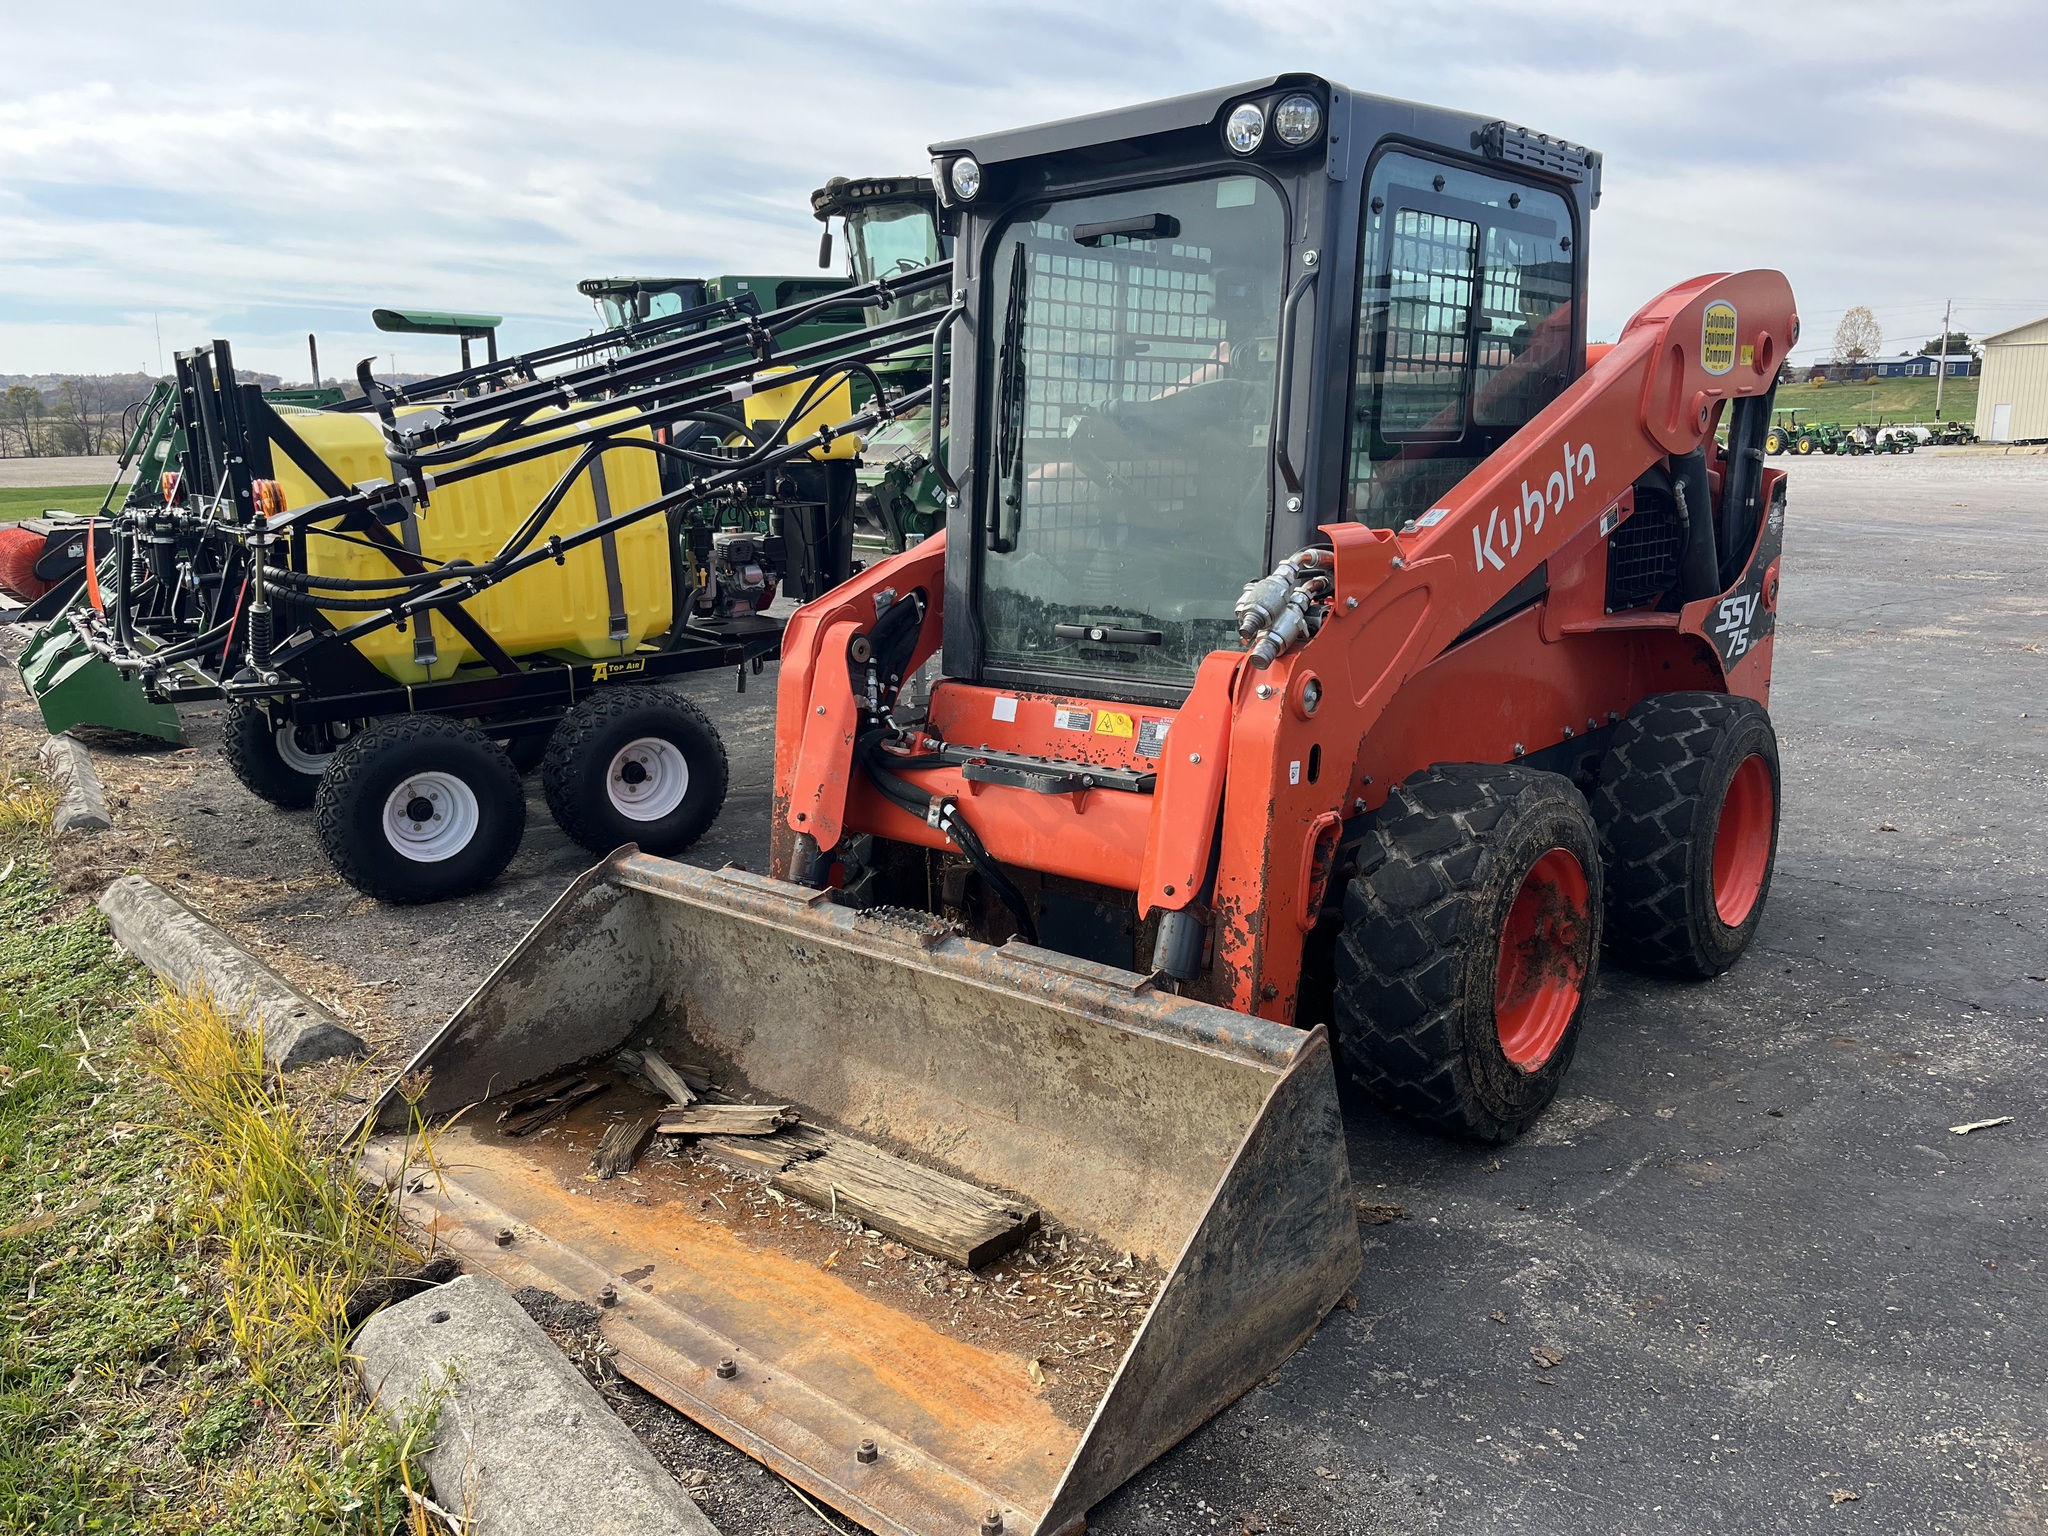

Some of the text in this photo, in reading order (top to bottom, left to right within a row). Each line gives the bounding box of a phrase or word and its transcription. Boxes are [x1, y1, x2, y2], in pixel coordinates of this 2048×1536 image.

[1706, 312, 1735, 329] Columbus
[1705, 330, 1734, 347] Equipment
[1706, 347, 1732, 365] Company
[1472, 441, 1597, 573] Kubota
[1715, 592, 1761, 634] SSV
[1726, 627, 1750, 659] 75
